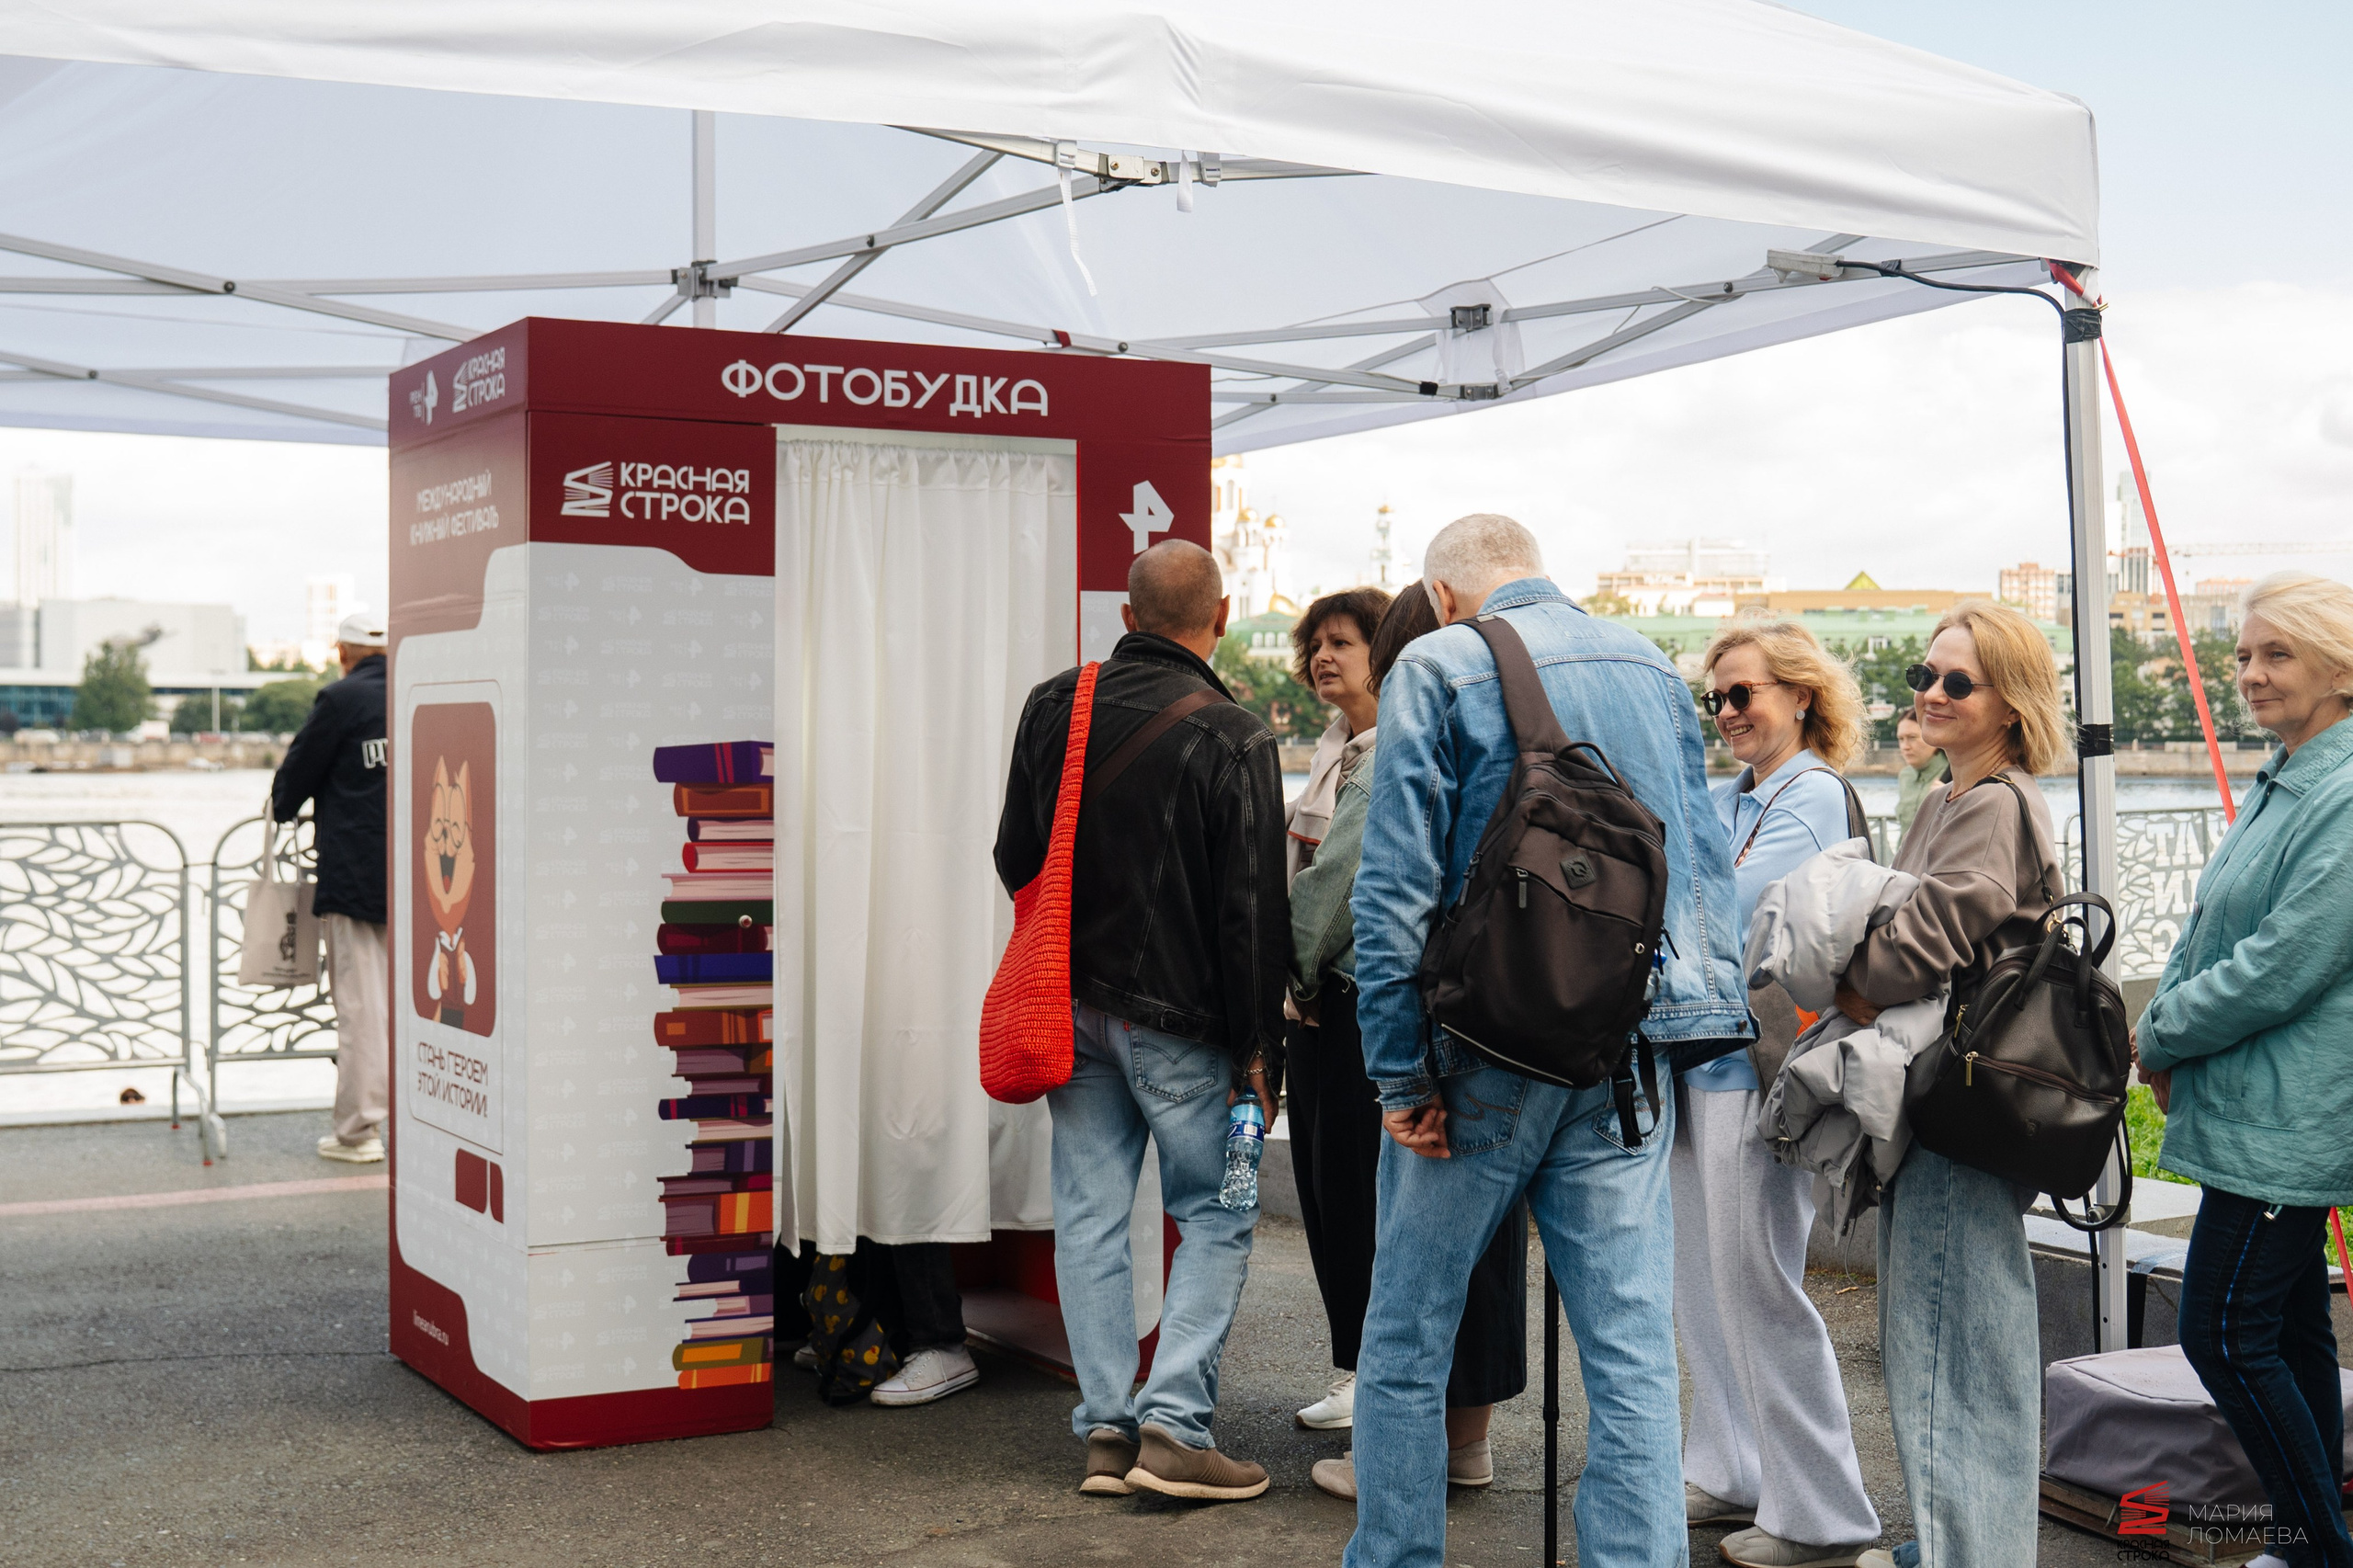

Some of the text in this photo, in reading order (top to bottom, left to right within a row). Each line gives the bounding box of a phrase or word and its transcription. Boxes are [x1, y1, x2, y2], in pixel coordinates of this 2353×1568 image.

[468, 347, 506, 380] КРАСНАЯ
[467, 372, 506, 407] СТРОКА
[721, 359, 1048, 417] ФОТОБУДКА
[416, 469, 492, 513] МЕЖДУНАРОДНЫЙ
[620, 461, 750, 494] КРАСНАЯ
[410, 505, 499, 546] КНИЖНЫЙ ФЕСТИВАЛЬ
[620, 491, 750, 525] СТРОКА
[418, 1041, 489, 1085] СТАНЬ ГЕРОЕМ
[418, 1071, 441, 1100] ЭТОЙ
